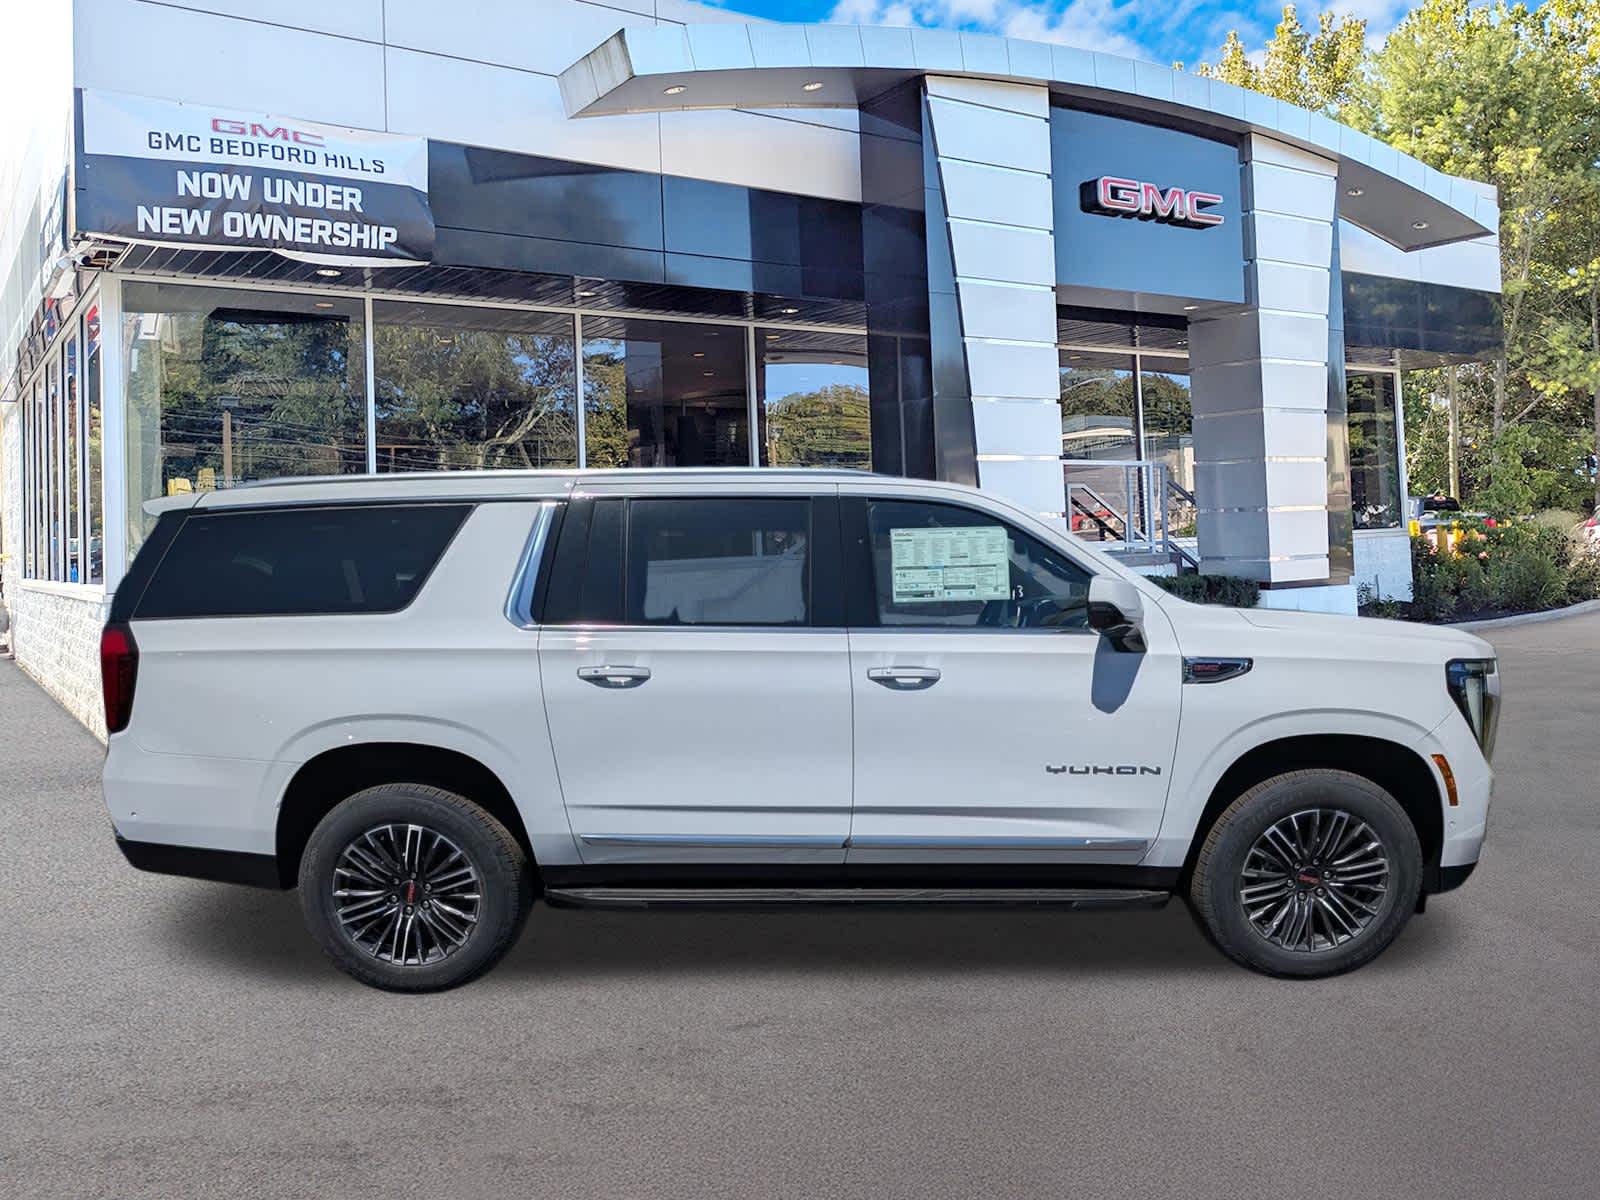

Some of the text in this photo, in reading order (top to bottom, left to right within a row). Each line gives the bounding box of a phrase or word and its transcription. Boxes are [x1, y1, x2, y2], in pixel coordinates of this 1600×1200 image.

[148, 131, 385, 174] GMC BEDFORD HILLS
[211, 118, 326, 148] GMC
[176, 170, 364, 213] NOW UNDER
[1095, 175, 1225, 226] GMC
[136, 205, 398, 250] NEW OWNERSHIP
[1045, 764, 1162, 776] YUKON
